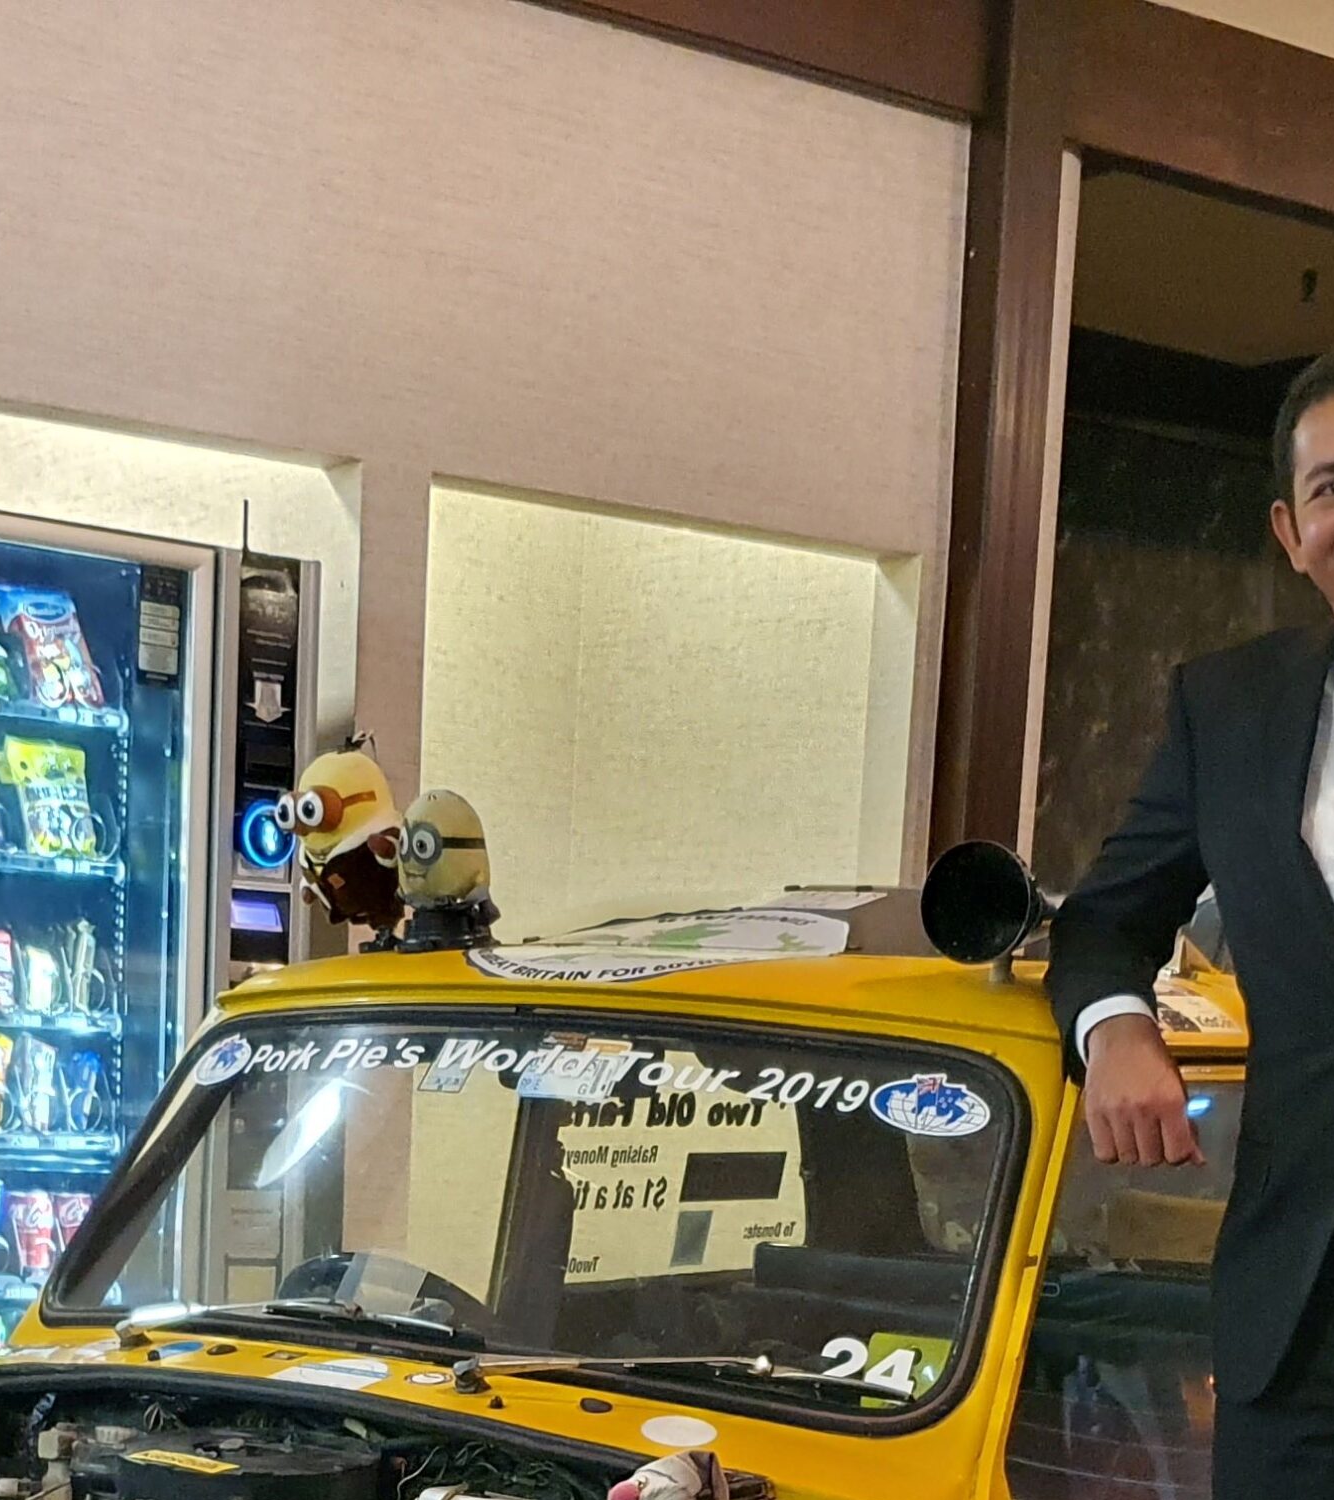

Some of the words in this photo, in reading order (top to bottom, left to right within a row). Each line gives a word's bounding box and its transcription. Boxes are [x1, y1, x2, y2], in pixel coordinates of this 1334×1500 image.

[511, 965, 592, 981] BRITAIN
[597, 966, 647, 979] FOR
[243, 1041, 320, 1075] Pork
[320, 1038, 426, 1070] Pie's
[437, 1038, 600, 1079] World
[613, 1050, 741, 1097] Tour
[747, 1066, 870, 1112] 2019
[821, 1337, 915, 1395] 24
